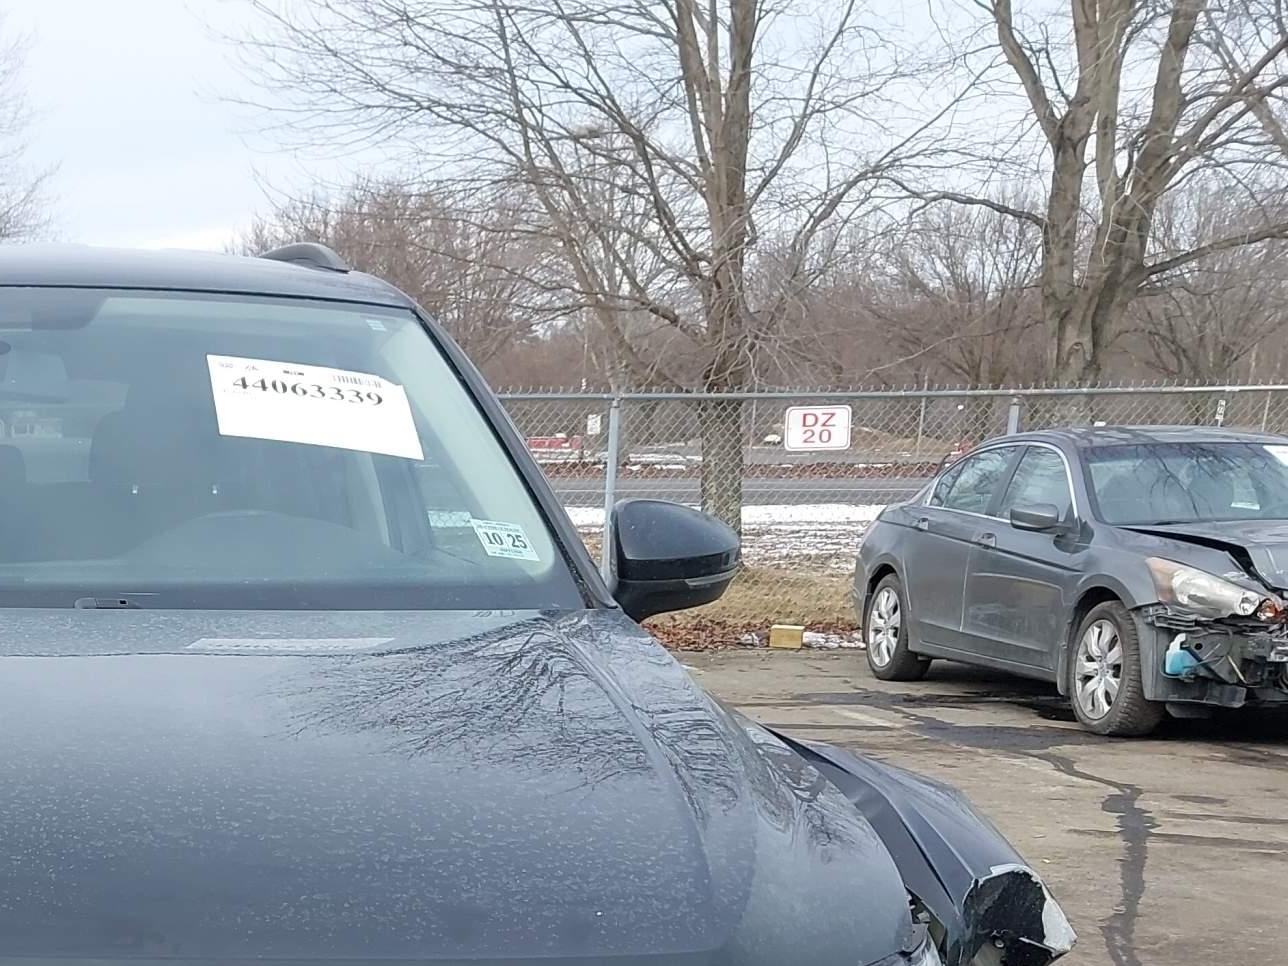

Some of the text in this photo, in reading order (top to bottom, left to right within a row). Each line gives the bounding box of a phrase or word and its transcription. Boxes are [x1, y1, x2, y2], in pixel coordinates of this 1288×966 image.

[232, 376, 383, 406] 44063339
[802, 412, 837, 428] DZ
[802, 429, 832, 444] 20
[483, 531, 528, 549] 10 25
